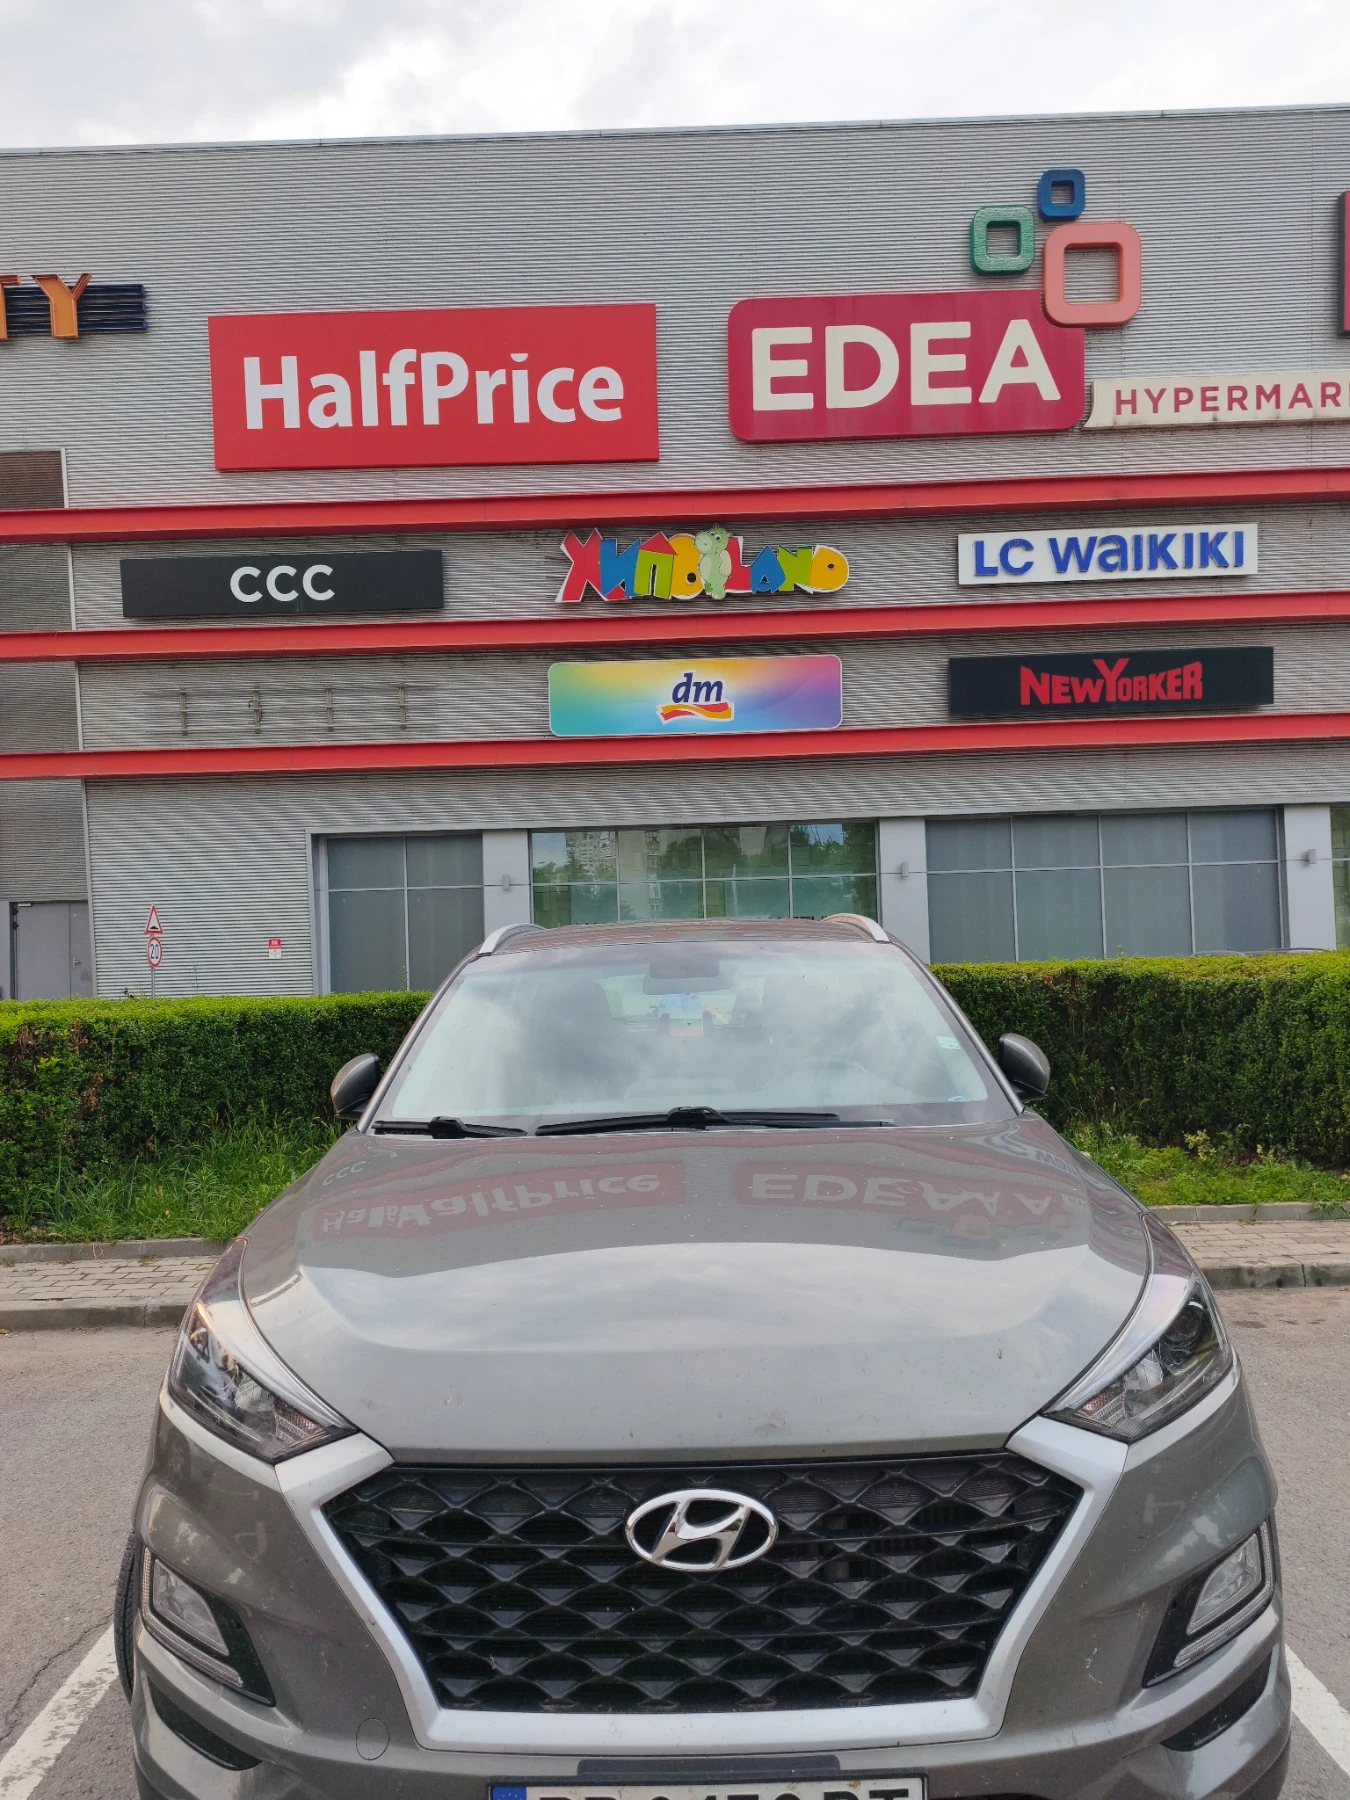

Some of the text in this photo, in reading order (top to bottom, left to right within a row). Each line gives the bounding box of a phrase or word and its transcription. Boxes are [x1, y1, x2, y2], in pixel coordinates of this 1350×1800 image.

[751, 319, 1061, 410] EDEA
[243, 349, 624, 430] HalfPrice
[1116, 382, 1350, 415] HYPERMAR
[975, 540, 1033, 576] LC
[229, 564, 335, 603] CCC
[672, 672, 723, 704] dm
[150, 943, 159, 959] 20
